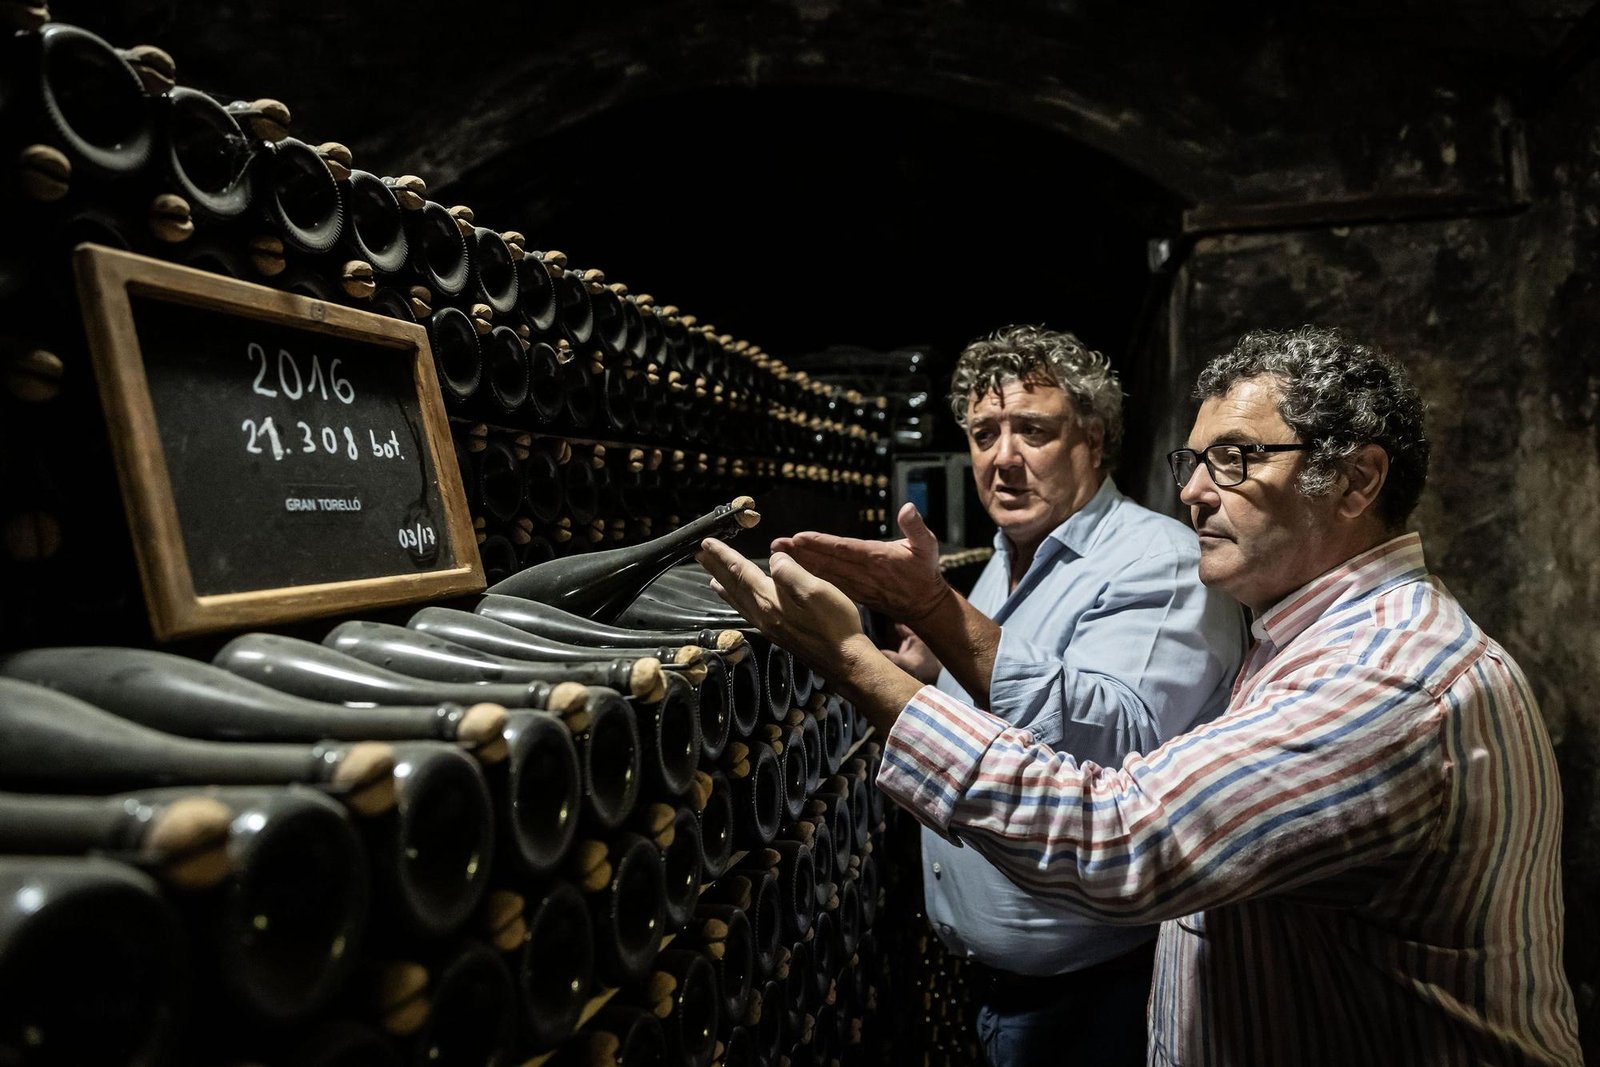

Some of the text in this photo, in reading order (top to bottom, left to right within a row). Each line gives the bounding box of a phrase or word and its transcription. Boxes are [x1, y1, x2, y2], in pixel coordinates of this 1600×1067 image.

[248, 342, 355, 404] 2016
[285, 497, 362, 511] GRAN TORELLÓ
[399, 523, 436, 555] 03/17
